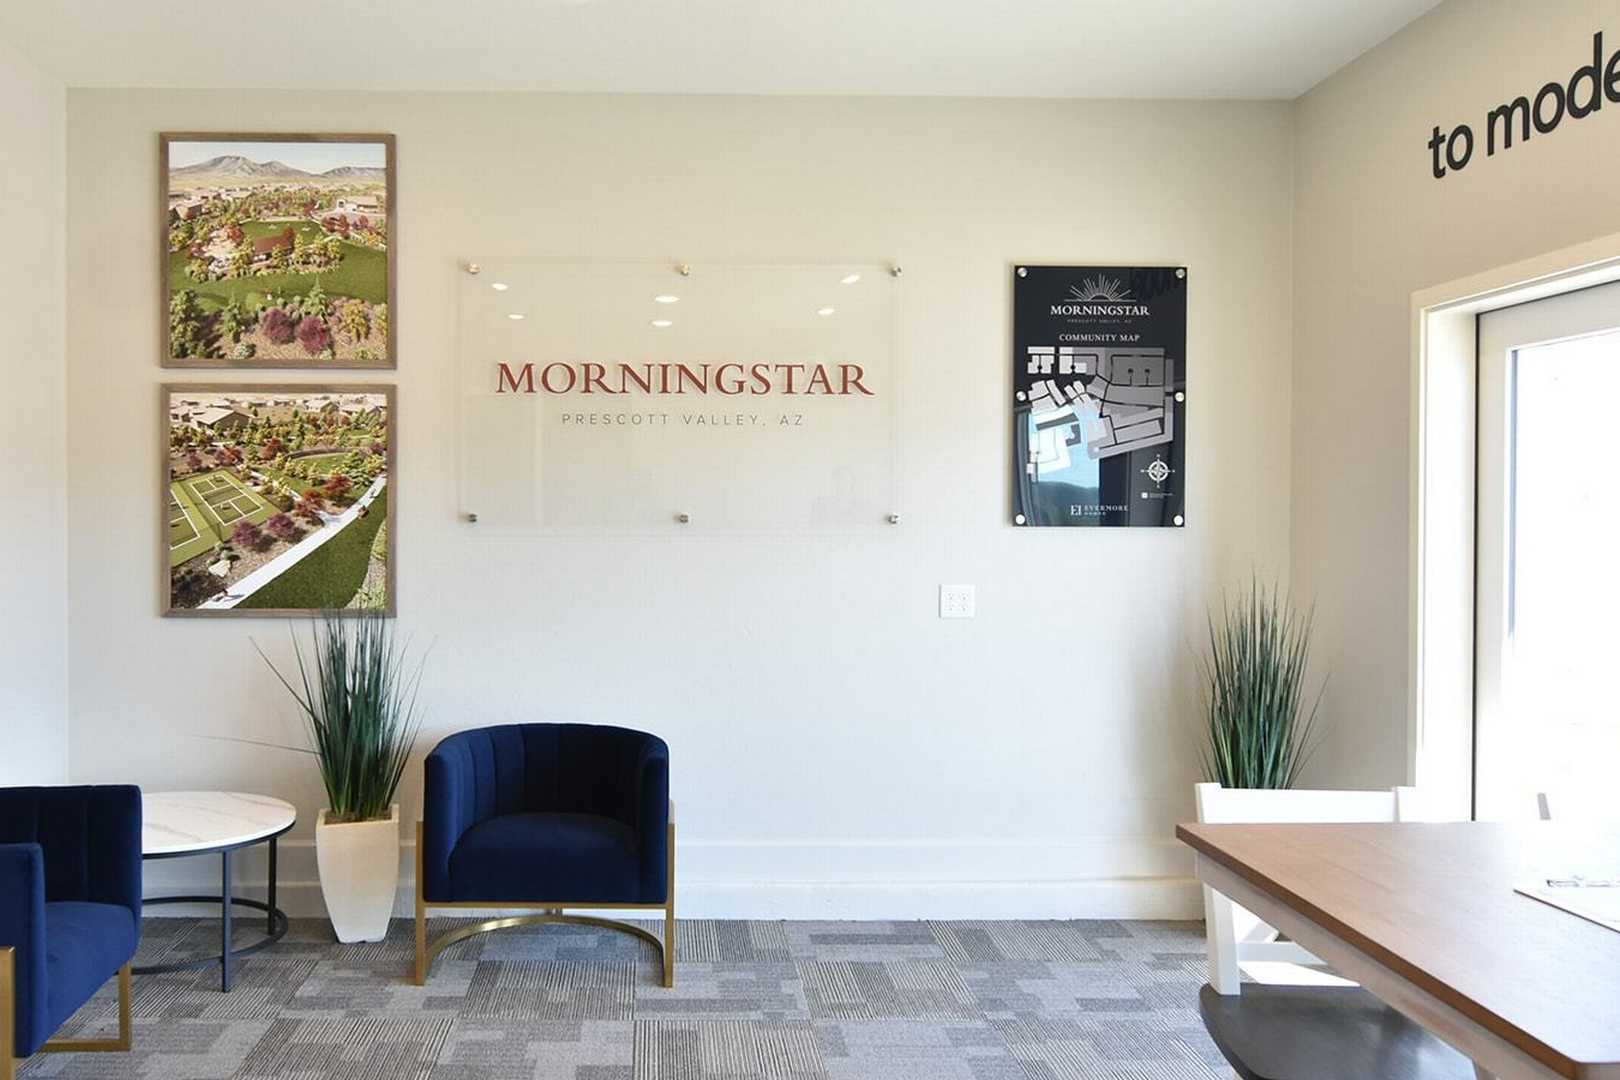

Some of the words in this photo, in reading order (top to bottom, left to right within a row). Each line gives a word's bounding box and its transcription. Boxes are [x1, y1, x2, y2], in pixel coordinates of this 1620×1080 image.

[1428, 125, 1474, 179] to
[1050, 305, 1150, 316] MORNINGSTAR
[1059, 334, 1117, 342] COMMUNITY
[1120, 334, 1140, 342] MAP
[495, 362, 875, 396] MORNINGSTAR
[562, 413, 669, 425] PRESCOTT
[683, 414, 766, 427] VALLEY,
[779, 415, 804, 426] AZ
